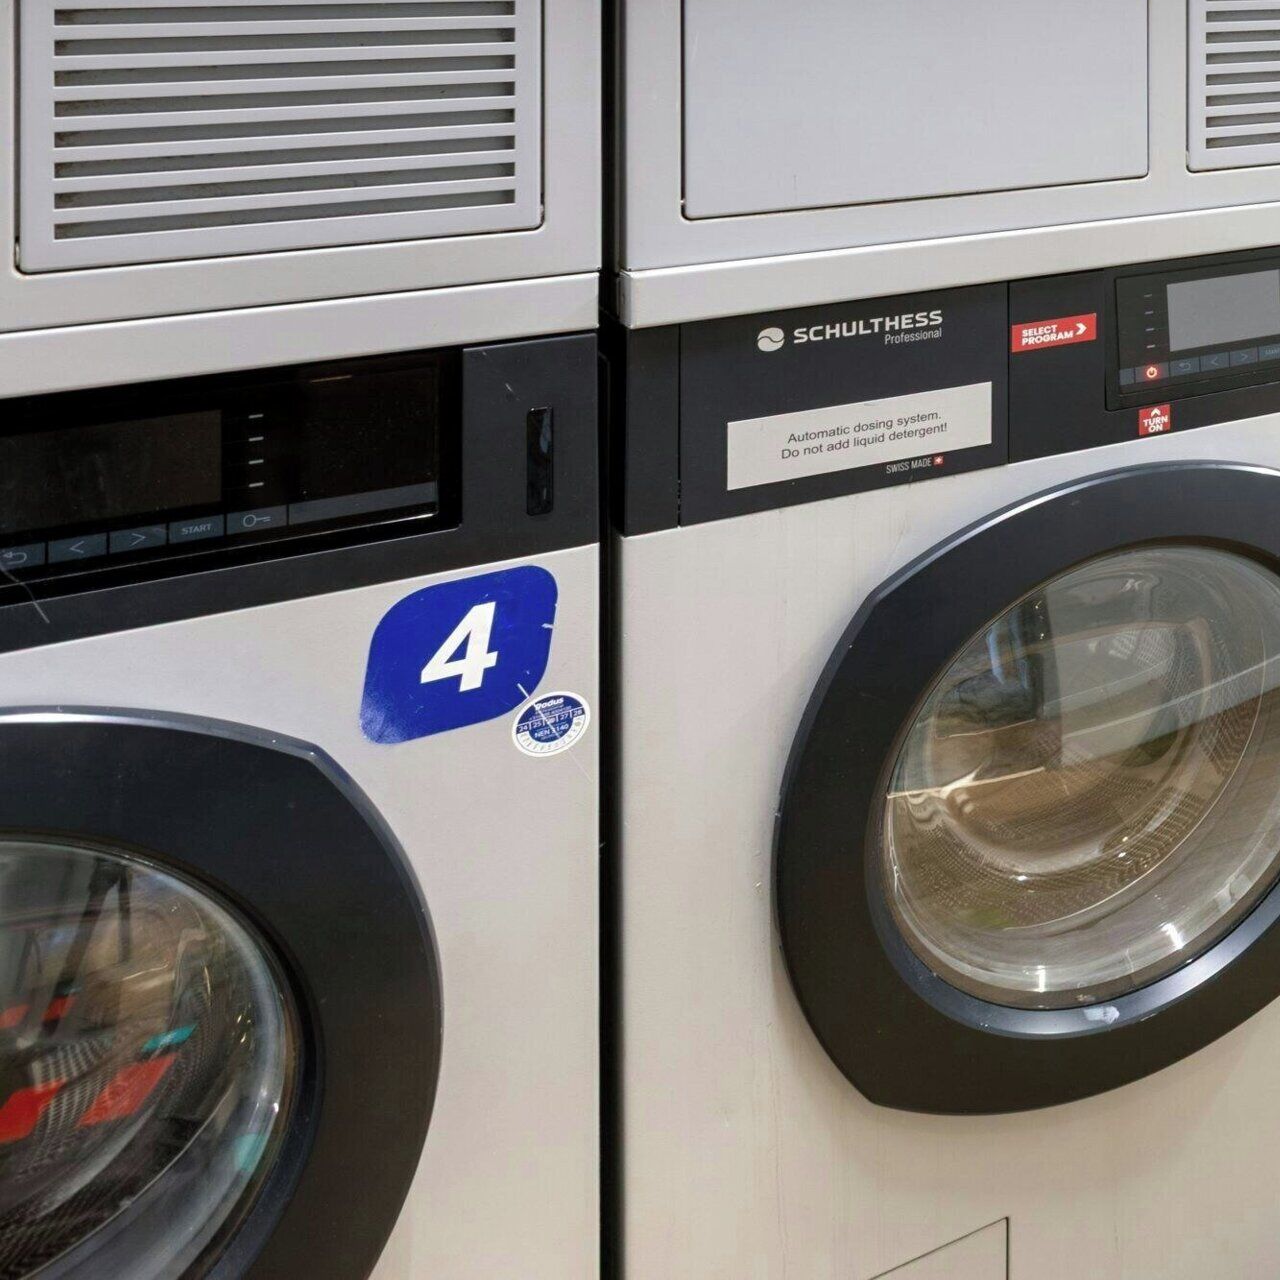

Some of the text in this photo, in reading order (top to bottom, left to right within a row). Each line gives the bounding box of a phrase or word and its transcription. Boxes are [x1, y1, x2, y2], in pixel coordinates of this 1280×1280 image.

[794, 310, 943, 344] SCHULTHESS
[1022, 325, 1057, 337] SELECT
[884, 328, 942, 345] Professional
[1022, 330, 1073, 346] PROGRAM
[788, 412, 941, 444] Automatic dosing system.
[1143, 415, 1168, 427] TURN
[1148, 424, 1163, 433] ON
[781, 422, 947, 460] Do not add liquid detergent!
[886, 458, 932, 474] SWISS MADE
[181, 522, 212, 536] START
[420, 601, 498, 692] 4
